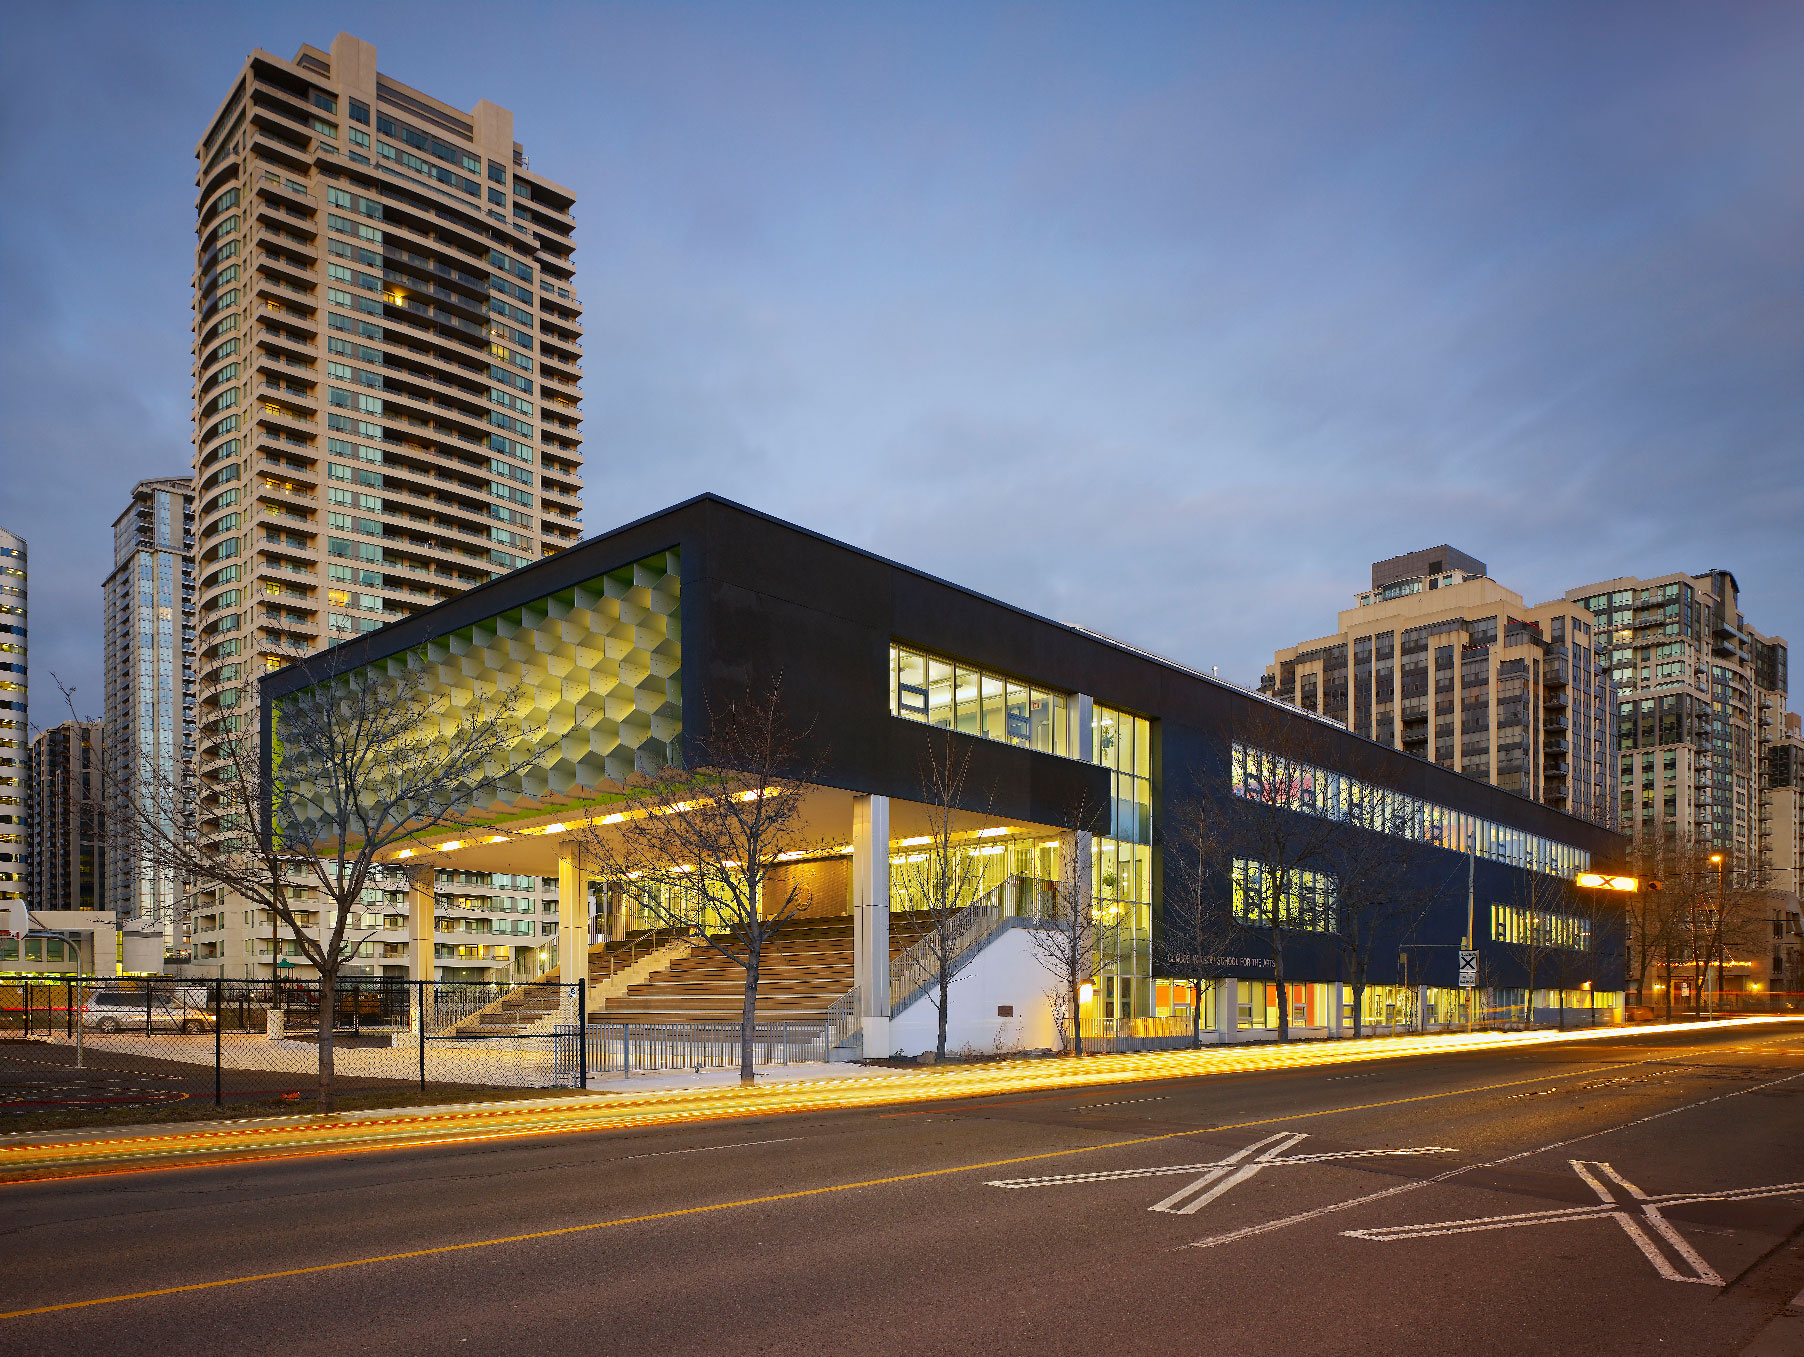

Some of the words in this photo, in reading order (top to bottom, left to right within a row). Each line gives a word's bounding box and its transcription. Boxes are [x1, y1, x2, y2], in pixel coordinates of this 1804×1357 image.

[1216, 956, 1239, 967] SCHOOL
[1240, 957, 1251, 968] FOR
[1251, 958, 1262, 968] THE
[1262, 958, 1276, 968] ARTS
